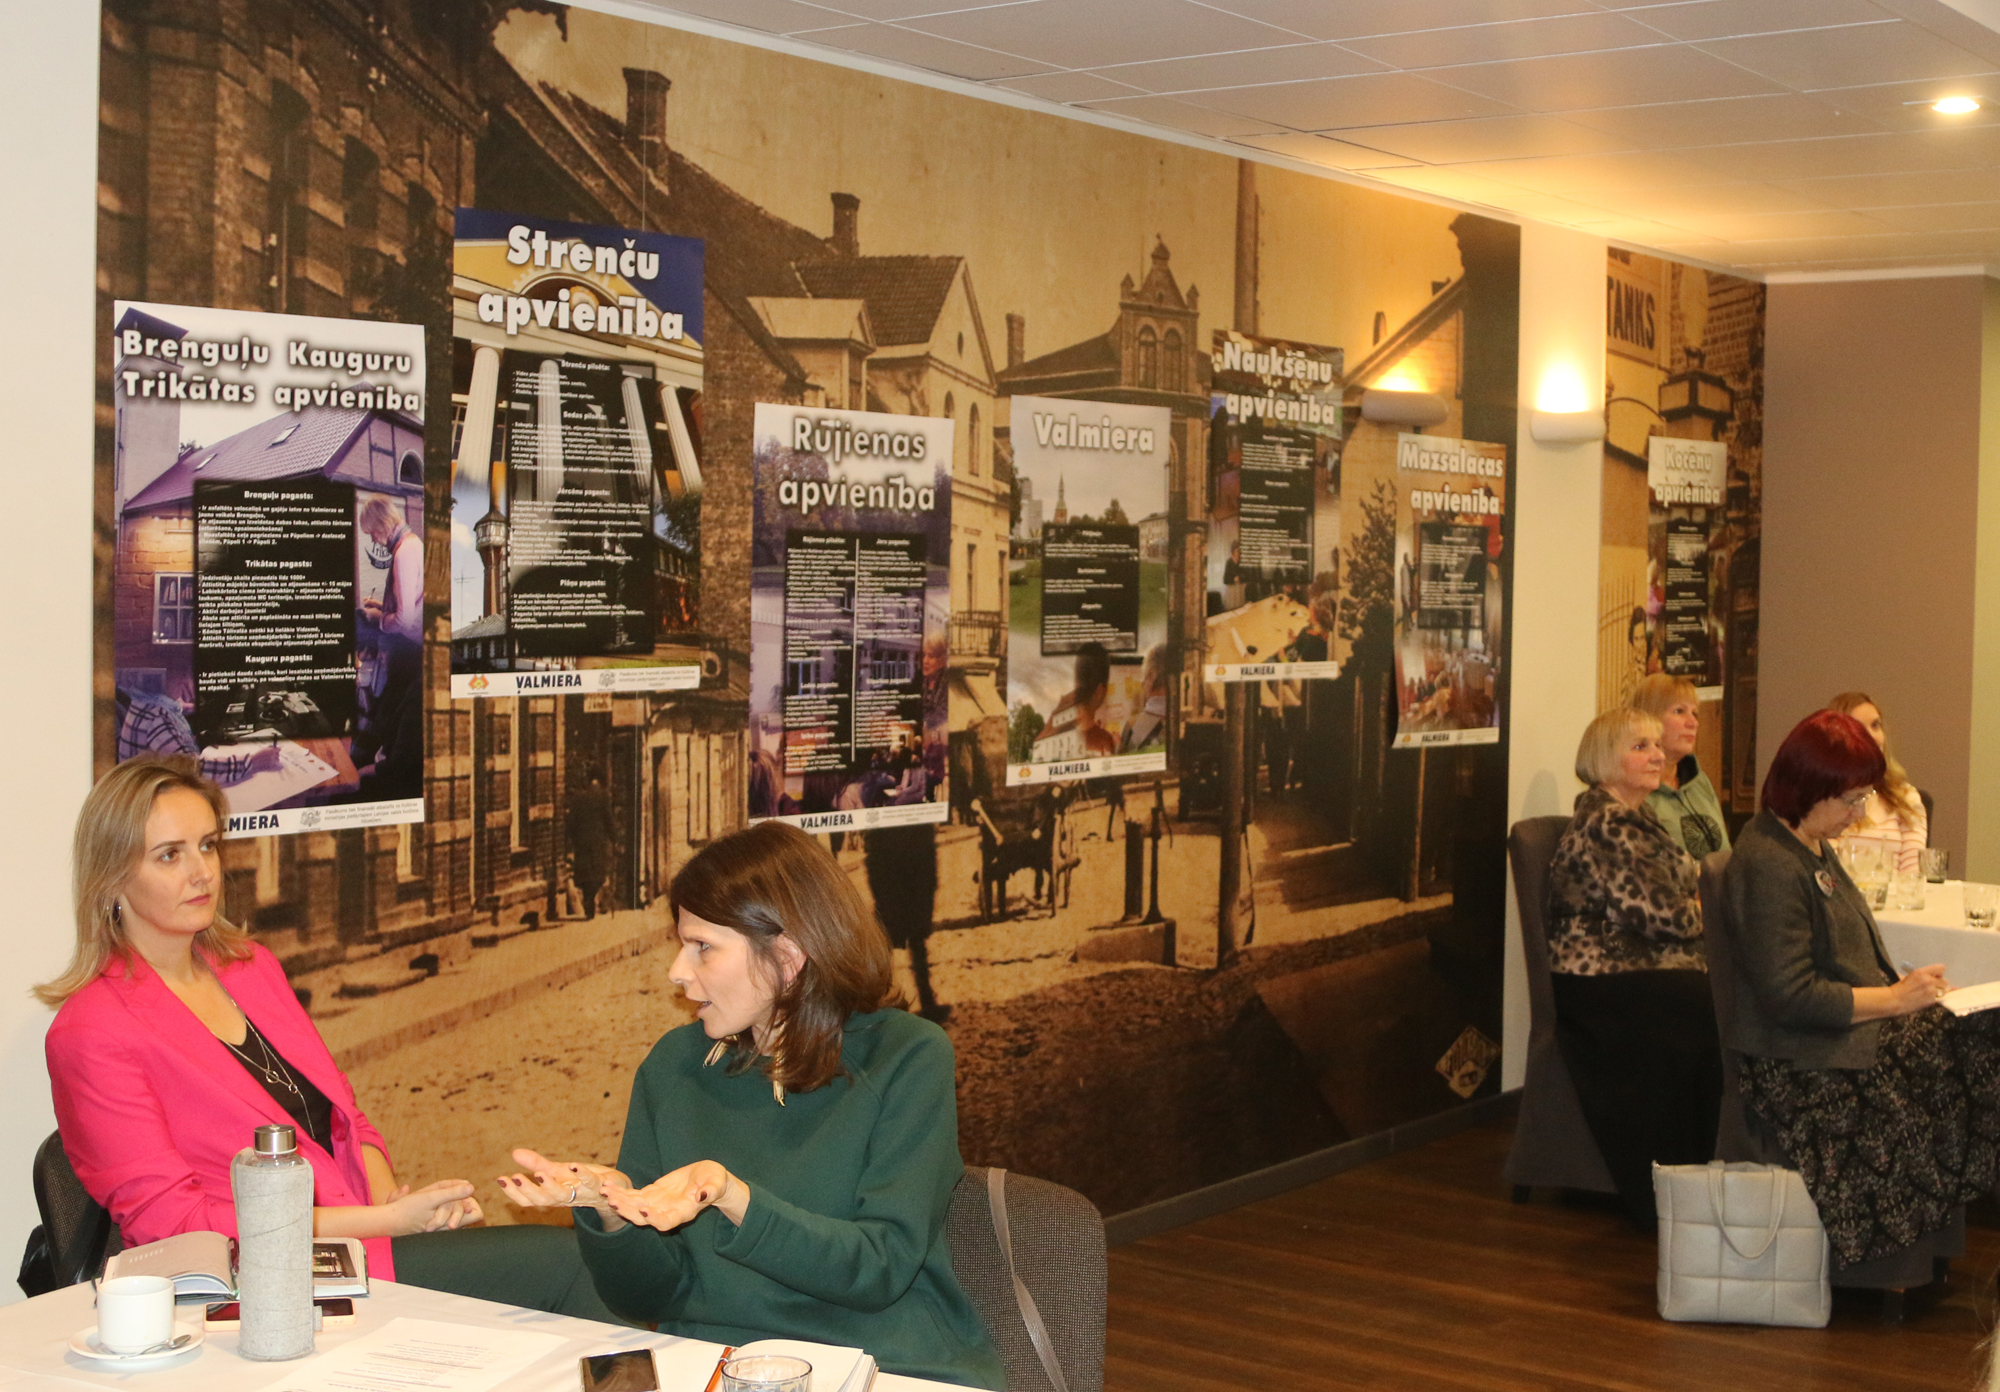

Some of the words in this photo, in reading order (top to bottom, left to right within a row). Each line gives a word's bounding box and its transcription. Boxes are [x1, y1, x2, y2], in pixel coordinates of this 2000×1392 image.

[507, 225, 659, 280] Strenču
[478, 288, 684, 340] apvienība
[122, 329, 270, 370] Brenguļu
[289, 341, 412, 375] Kauguru
[1223, 341, 1332, 383] Naukšēnu
[122, 371, 256, 402] Trikātas
[275, 382, 420, 411] apvienība
[1226, 389, 1335, 424] apvienība
[794, 417, 926, 462] Rūjienas
[1033, 413, 1154, 452] Valmiera
[1401, 442, 1504, 477] Mazsalacas
[244, 491, 279, 500] Brenguļu
[280, 492, 314, 500] pagasts:
[779, 476, 936, 515] apvienība
[1411, 484, 1500, 516] apvienība
[1655, 478, 1720, 508] apvienība
[280, 560, 312, 568] pagasts:
[246, 656, 278, 664] Kauguru
[280, 654, 312, 663] pagasts:
[1241, 666, 1275, 676] VALMIERA
[516, 674, 582, 689] VALMIERA
[1048, 762, 1090, 776] VALMIERA
[223, 814, 279, 832] MIERA
[800, 814, 853, 829] VALMIERA
